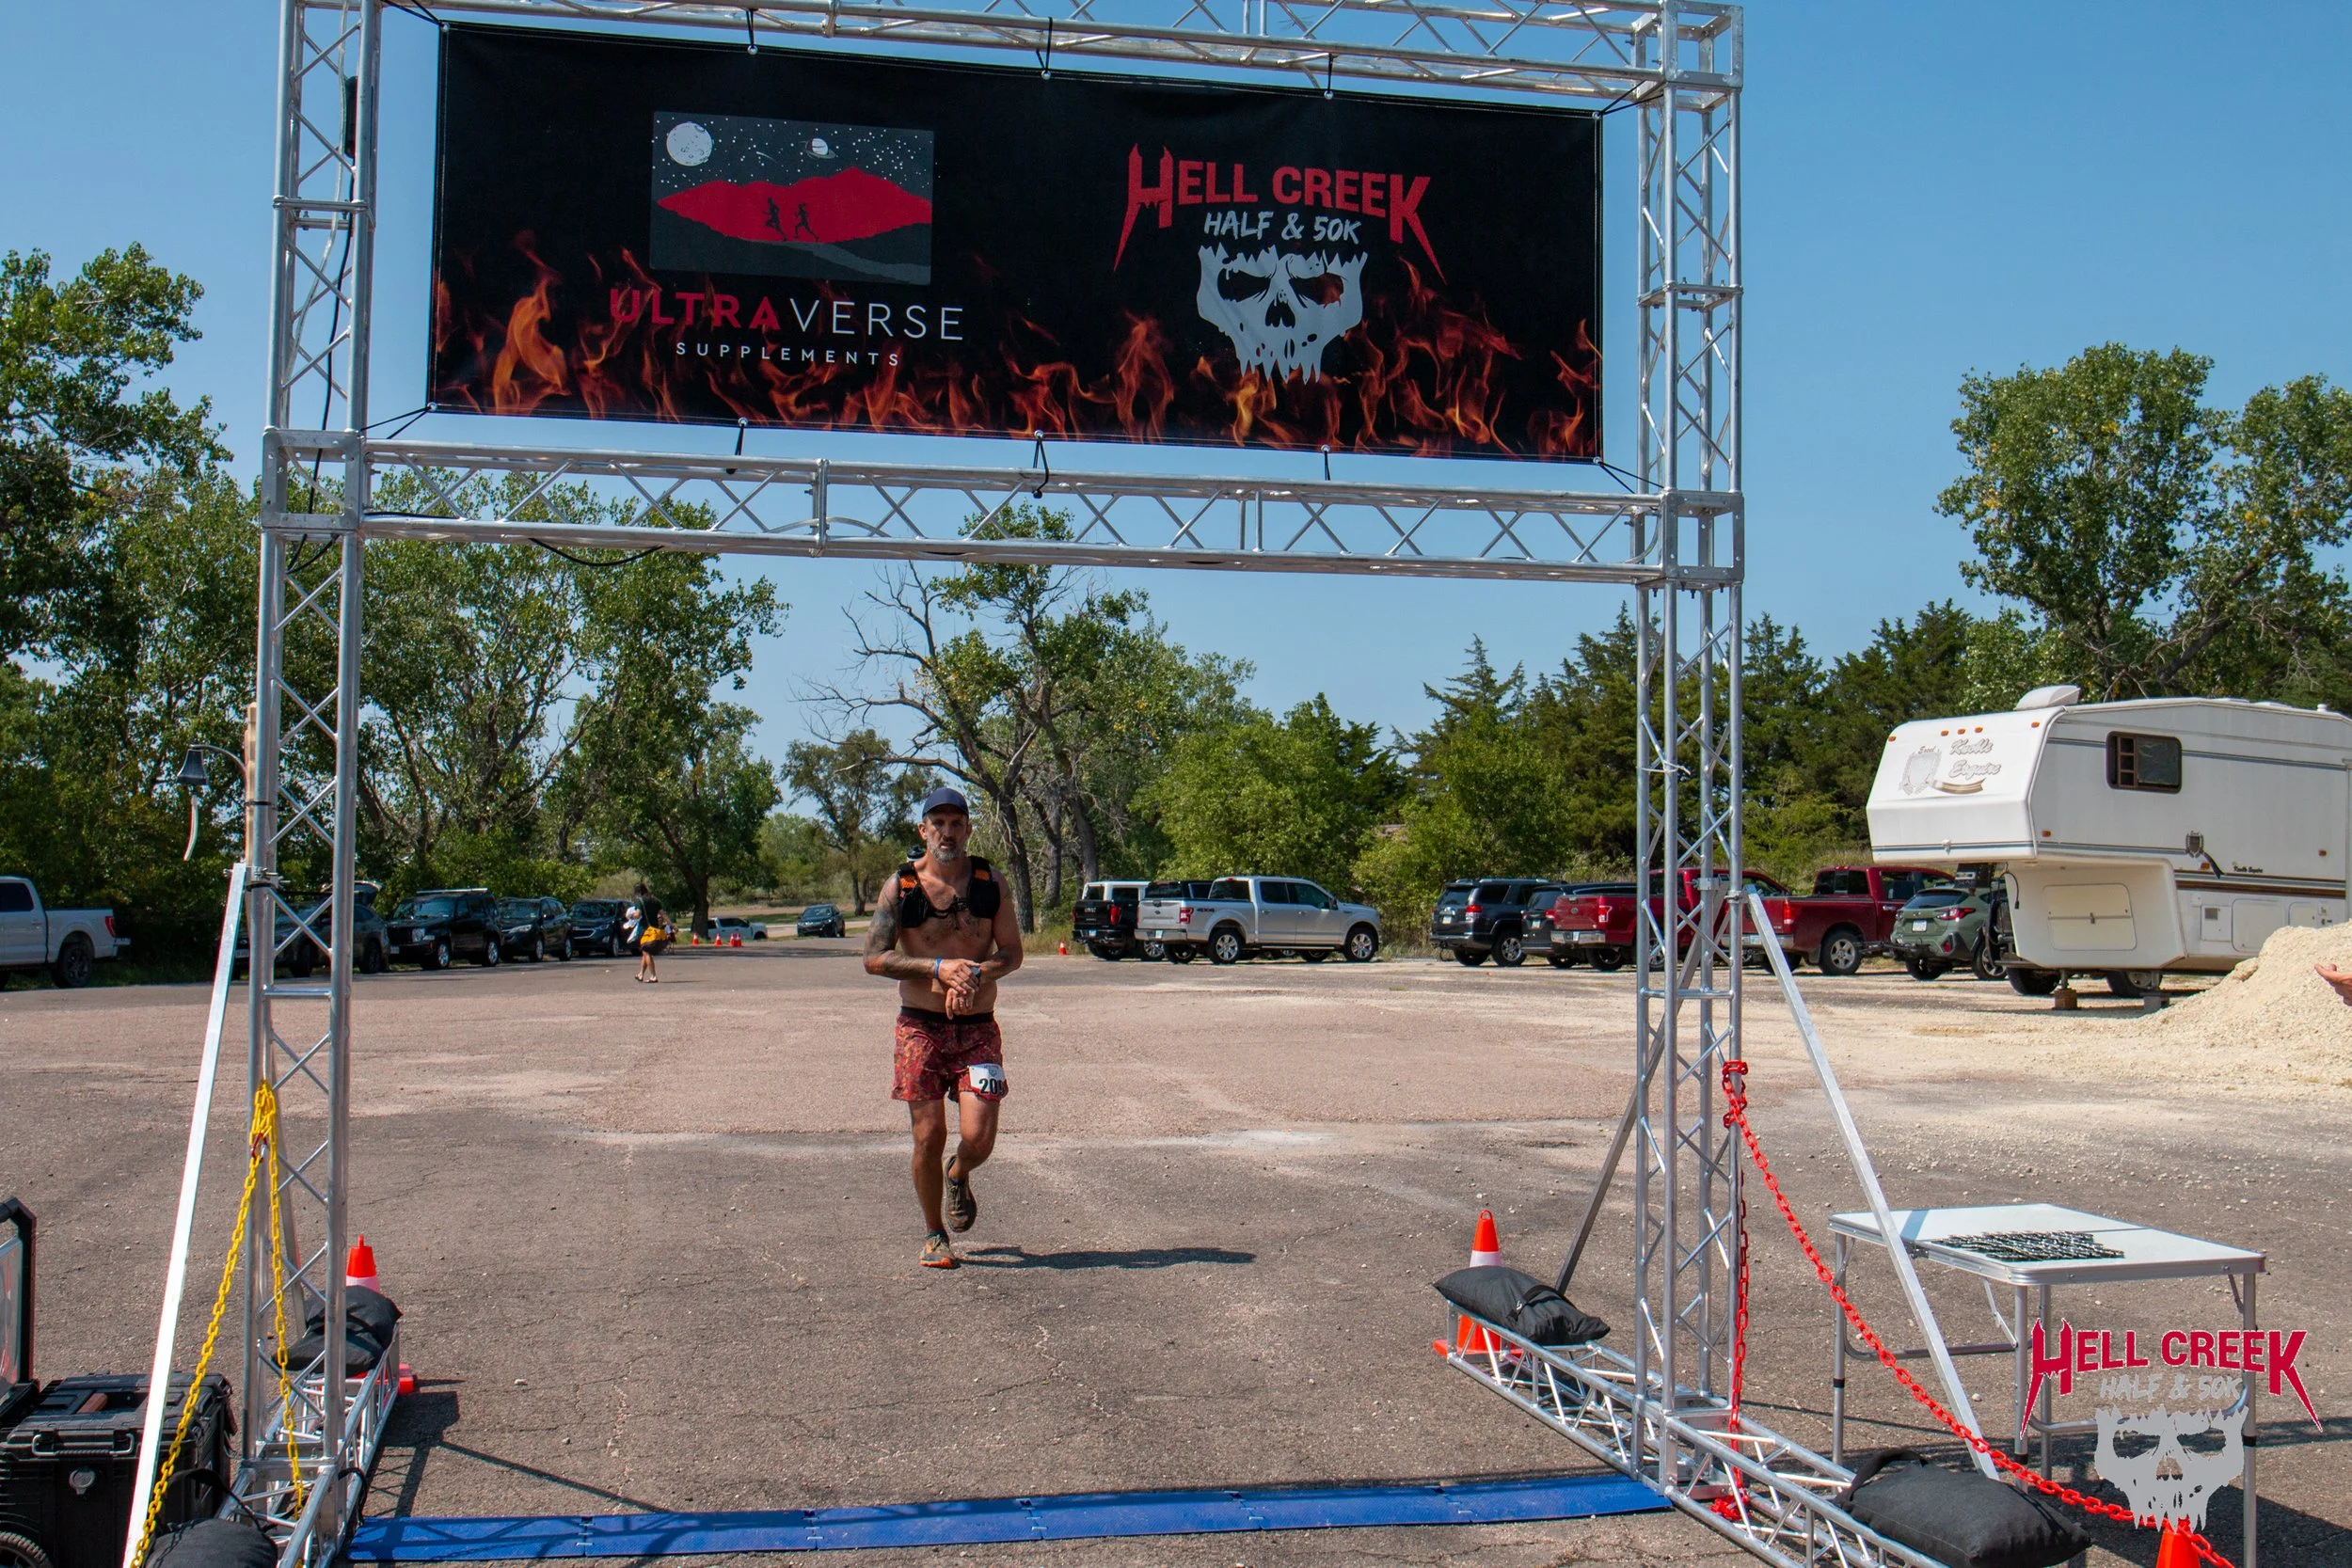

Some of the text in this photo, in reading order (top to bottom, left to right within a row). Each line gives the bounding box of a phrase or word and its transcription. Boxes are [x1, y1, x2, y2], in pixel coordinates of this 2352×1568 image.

[1113, 143, 1448, 286] HELL CREEK
[1203, 210, 1362, 245] HALF & 50K
[609, 288, 964, 341] ULTRAVERSE
[675, 341, 899, 367] SUPPLEMENTS
